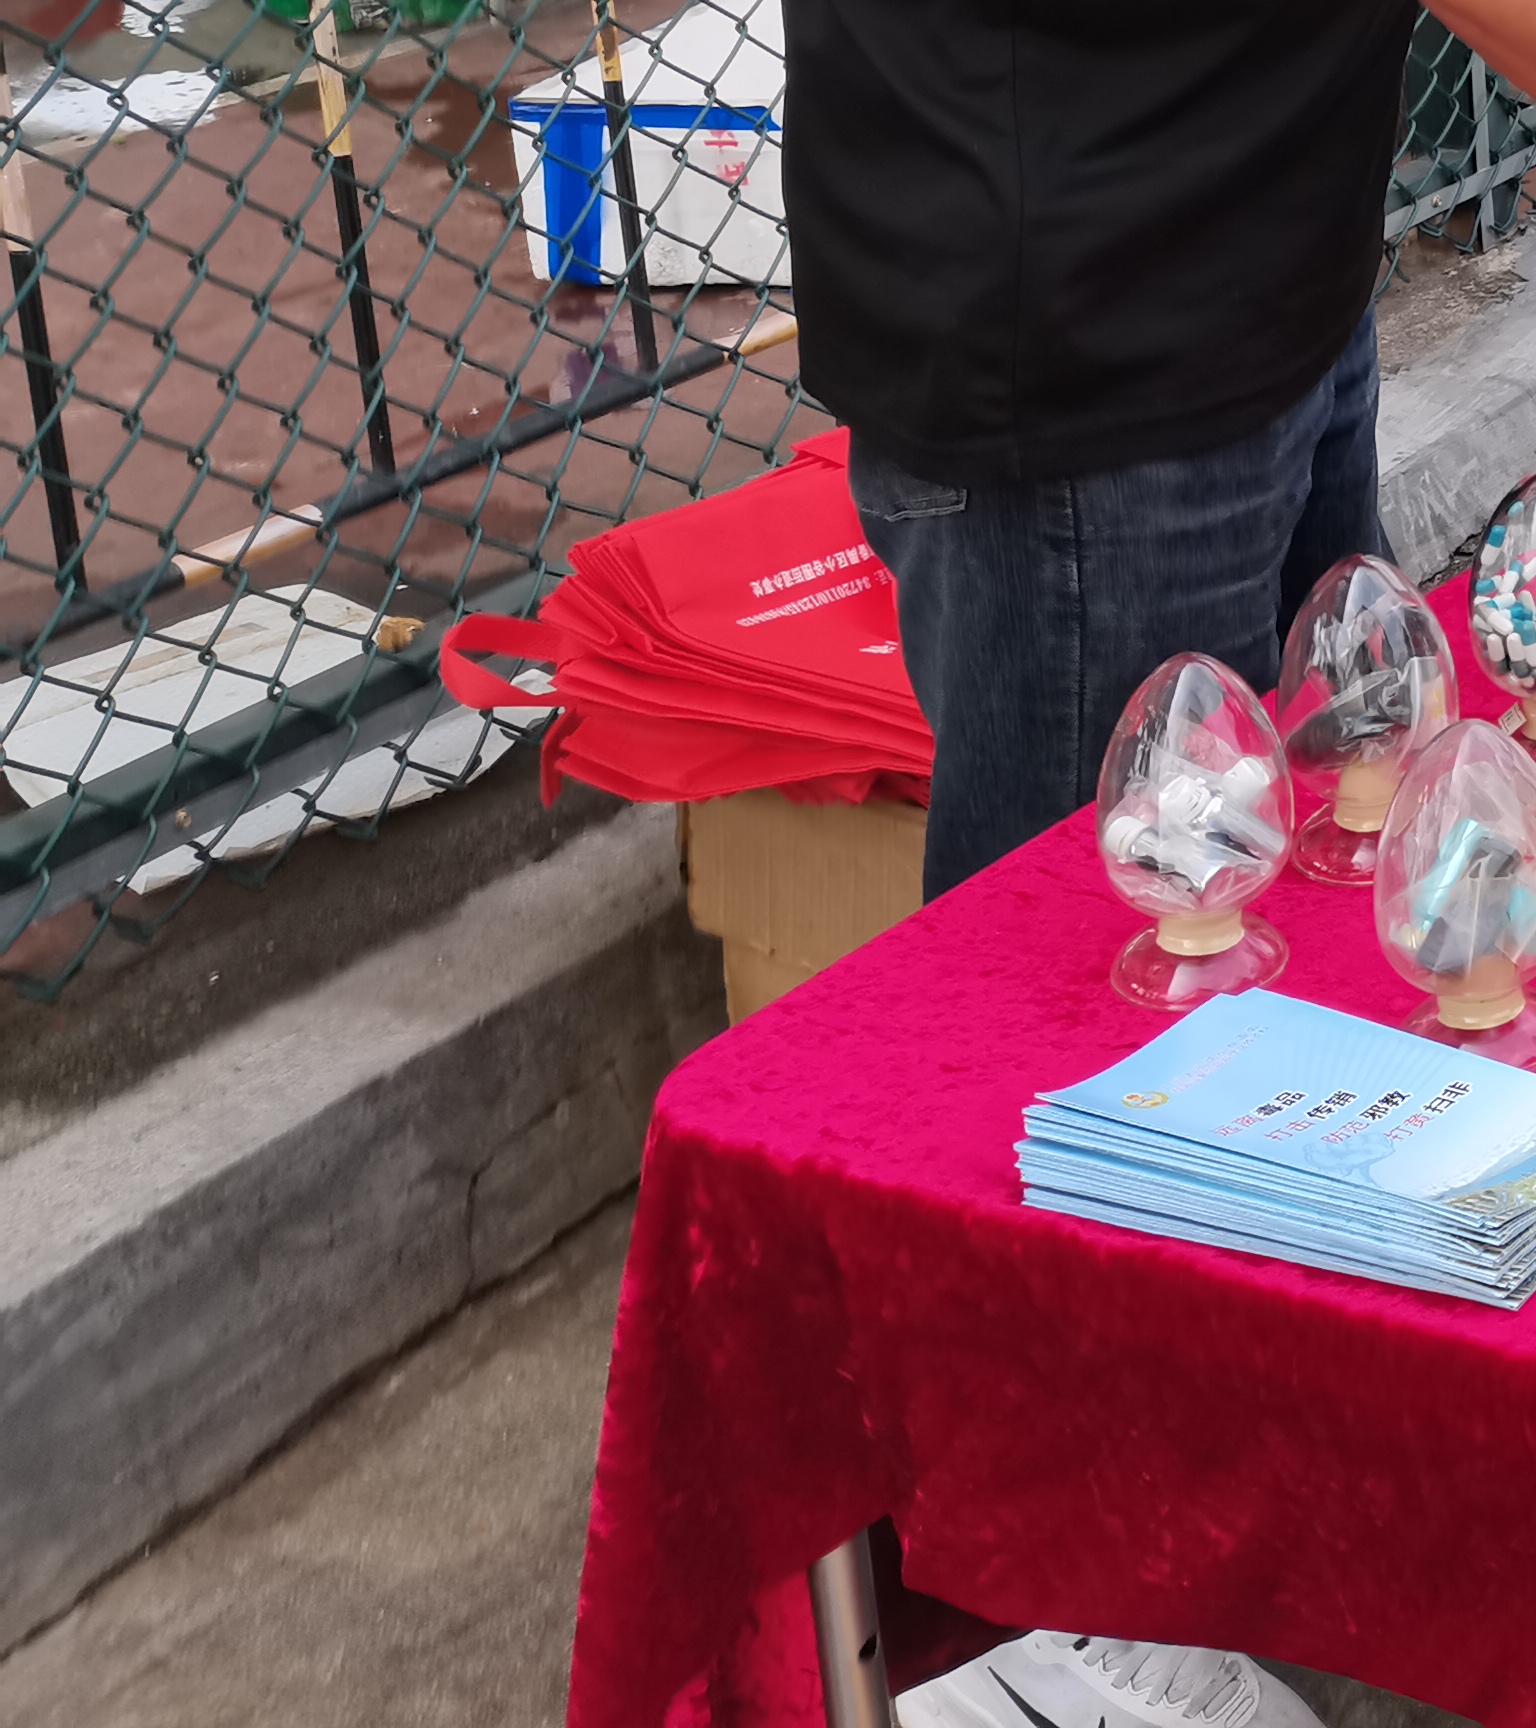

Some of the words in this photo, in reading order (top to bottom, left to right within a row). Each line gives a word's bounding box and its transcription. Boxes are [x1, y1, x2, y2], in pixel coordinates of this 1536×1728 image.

[750, 543, 876, 598] 番禺区小谷围街道办事处
[1212, 1089, 1308, 1138] 远离毒品
[1263, 1088, 1359, 1142] 打击传销
[1320, 1088, 1413, 1145] 防范邪教
